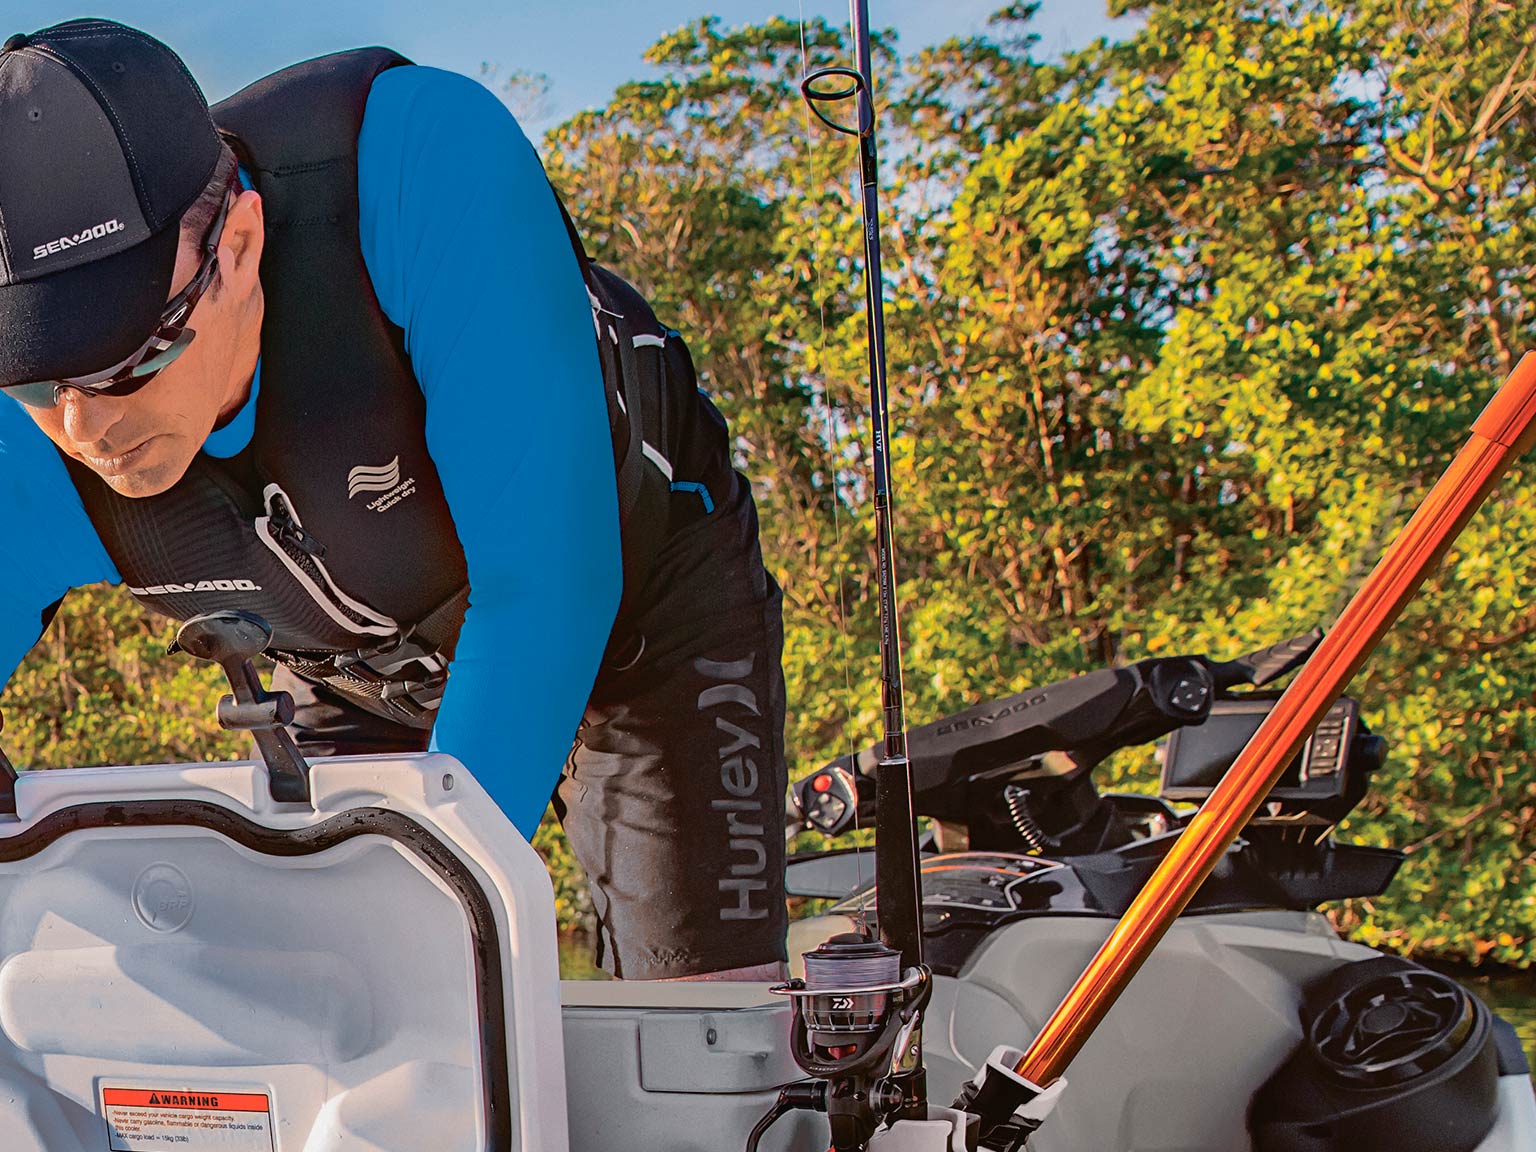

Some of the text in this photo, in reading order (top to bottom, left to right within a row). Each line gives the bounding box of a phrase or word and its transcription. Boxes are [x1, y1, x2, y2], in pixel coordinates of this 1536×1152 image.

[366, 477, 415, 510] Lightweight
[377, 486, 416, 512] Quick dry
[710, 717, 769, 920] Hurley
[161, 1095, 218, 1107] WARNING
[200, 1122, 227, 1130] dangerous
